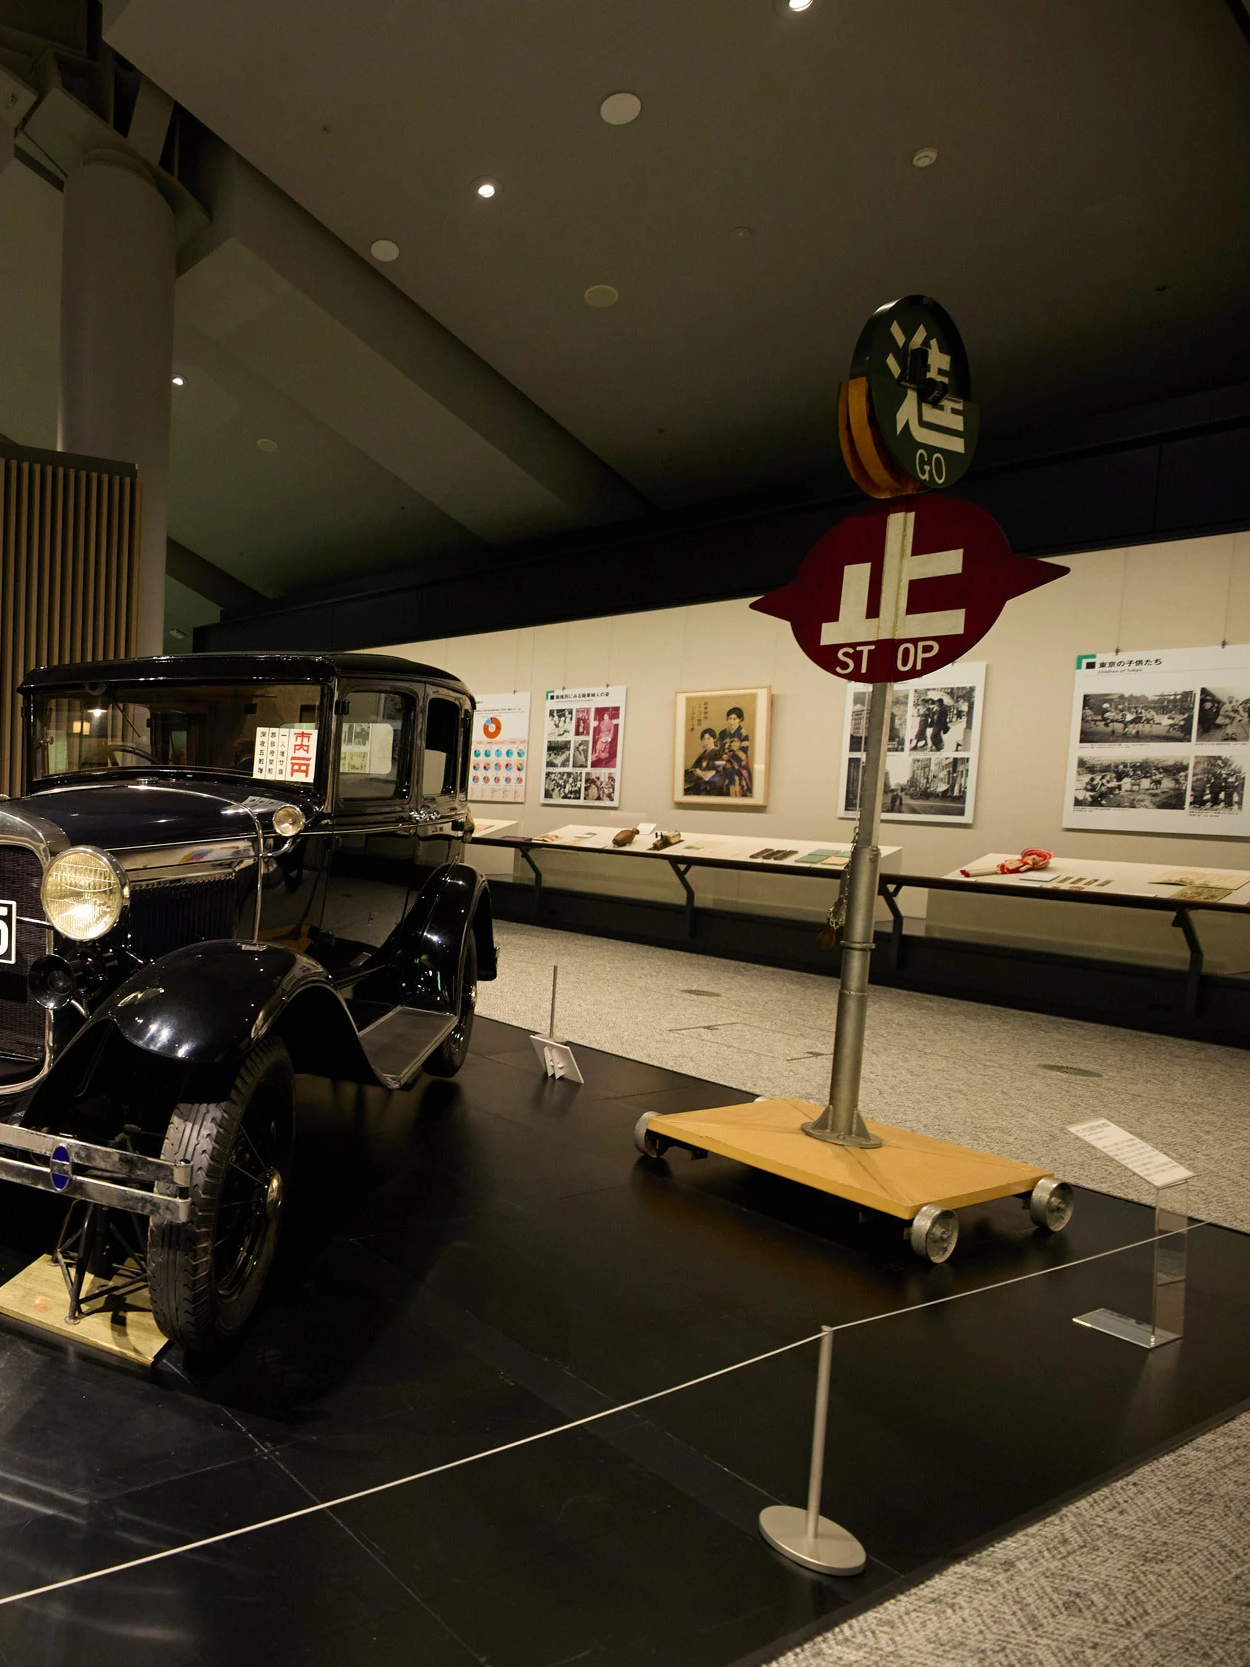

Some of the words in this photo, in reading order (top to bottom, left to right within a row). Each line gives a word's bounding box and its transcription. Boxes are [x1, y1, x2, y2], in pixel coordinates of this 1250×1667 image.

[916, 449, 945, 484] GO
[820, 511, 966, 645] 止
[1099, 658, 1162, 668] 東京の子供たち
